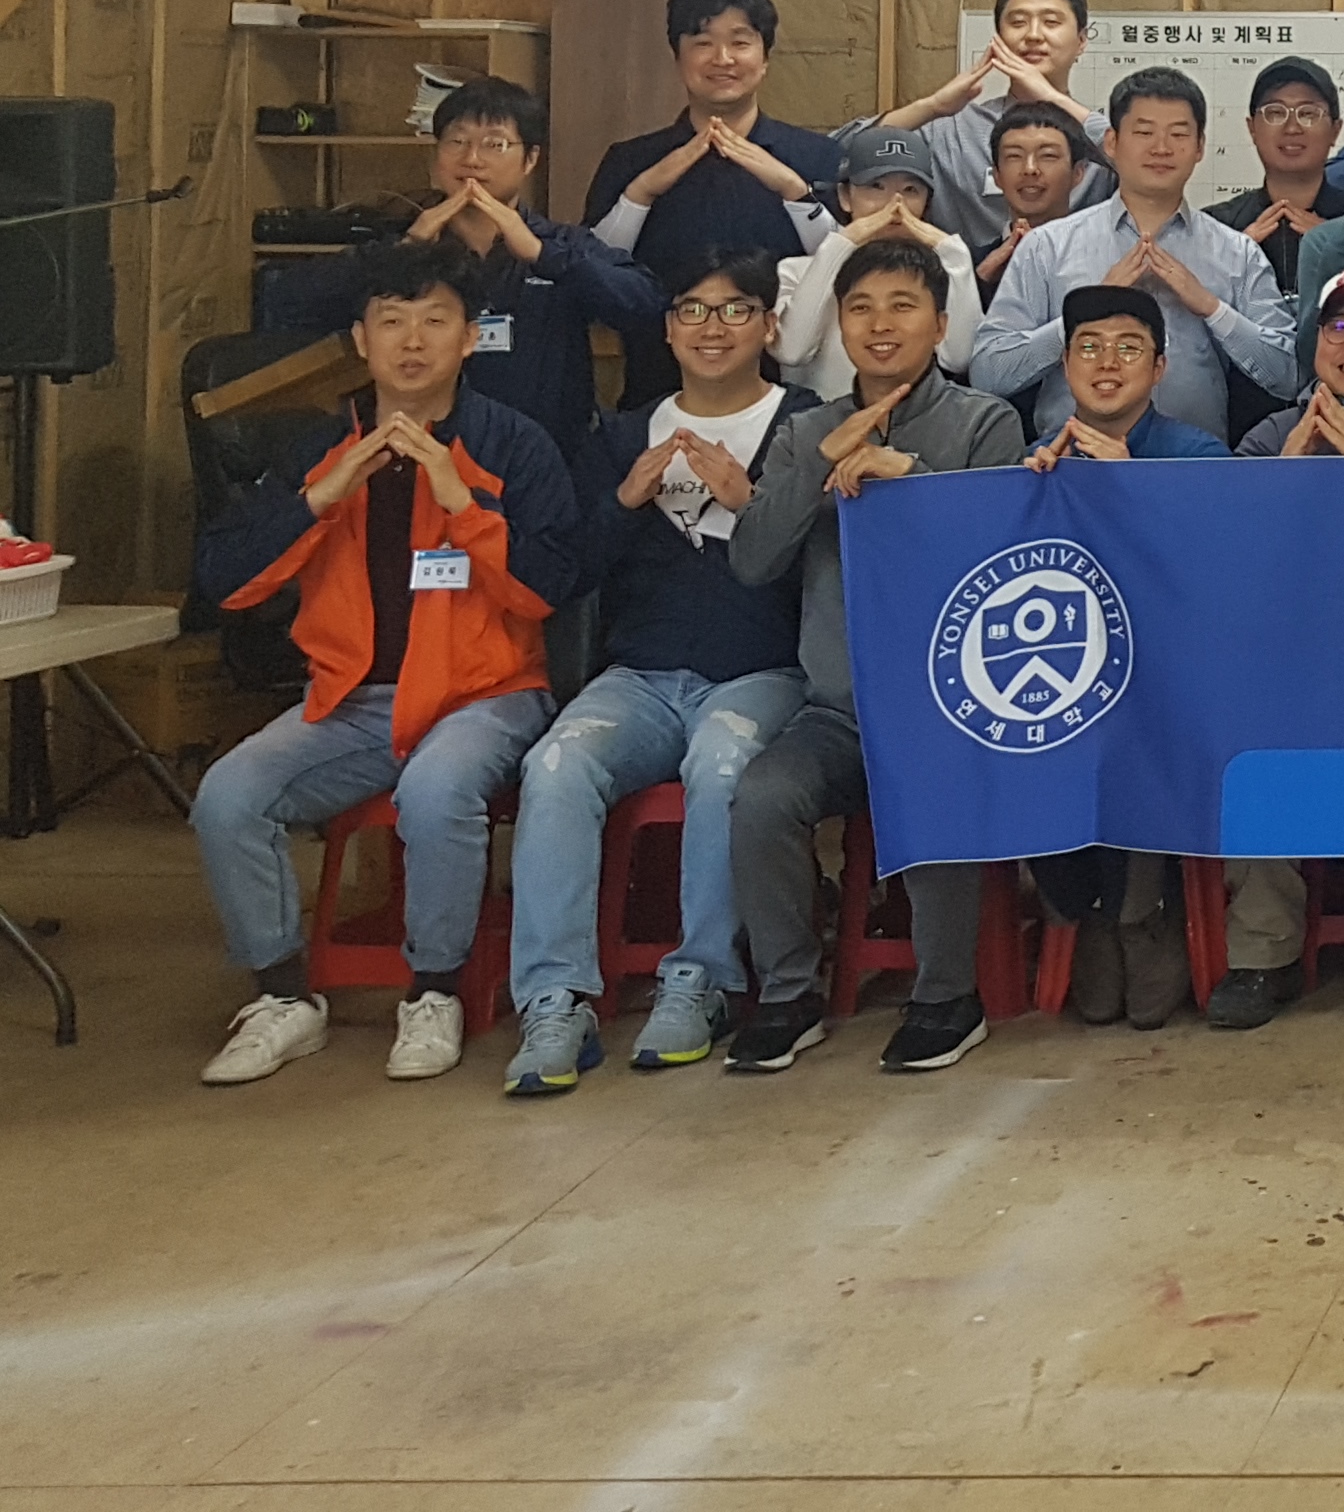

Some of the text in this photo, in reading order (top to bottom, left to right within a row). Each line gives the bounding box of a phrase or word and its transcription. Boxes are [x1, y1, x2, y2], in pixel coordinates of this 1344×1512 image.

[1121, 24, 1293, 44] 월중행사 및 계획표
[938, 547, 1126, 660] YONSEI UNIVERSITY
[1021, 689, 1051, 705] 1885
